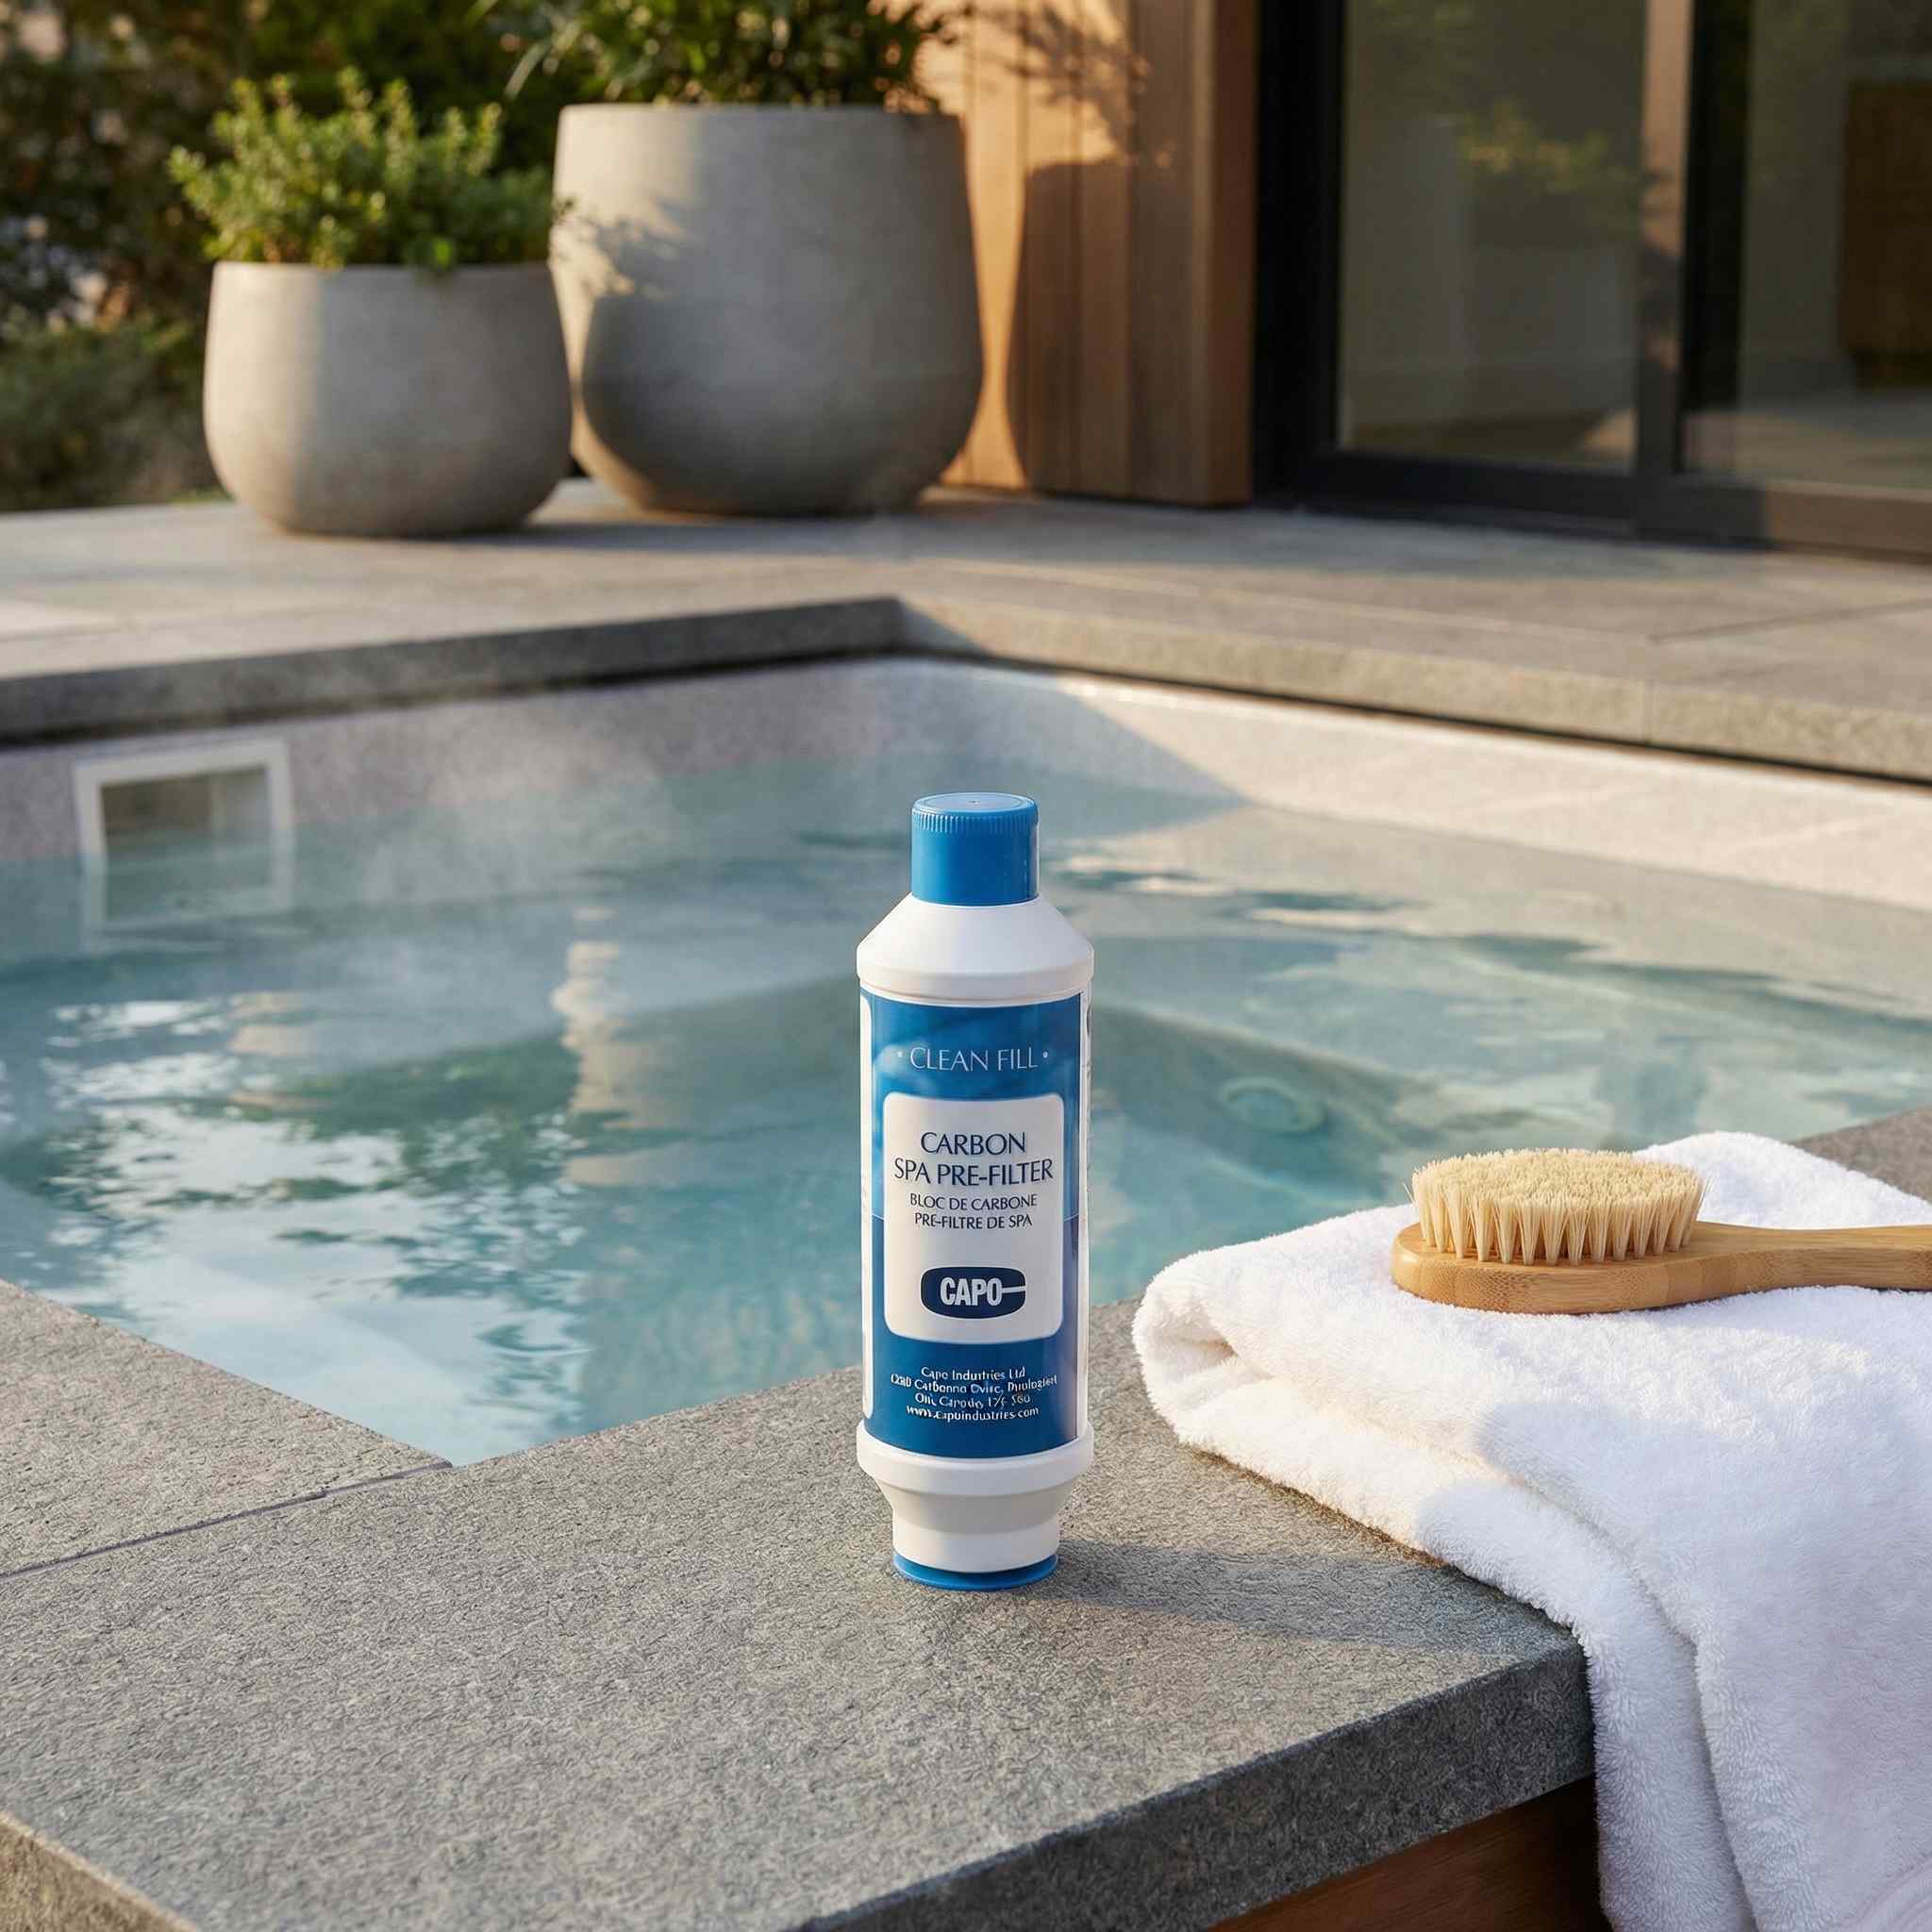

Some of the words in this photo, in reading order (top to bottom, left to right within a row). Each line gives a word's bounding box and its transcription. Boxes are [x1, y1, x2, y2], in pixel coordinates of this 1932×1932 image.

[910, 1047, 989, 1071] CLEAN
[998, 1047, 1038, 1070] FILL
[921, 1132, 1025, 1156] CARBON
[894, 1158, 931, 1184] SPA
[938, 1158, 1054, 1186] PRE-FILTER
[910, 1193, 945, 1209] BLOC
[949, 1198, 968, 1211] DE
[971, 1194, 1038, 1210] CARBONE
[915, 1212, 983, 1229] PRE-FILTRE
[987, 1217, 1005, 1229] DE
[1008, 1214, 1033, 1228] SPA
[940, 1277, 1003, 1307] CAPO
